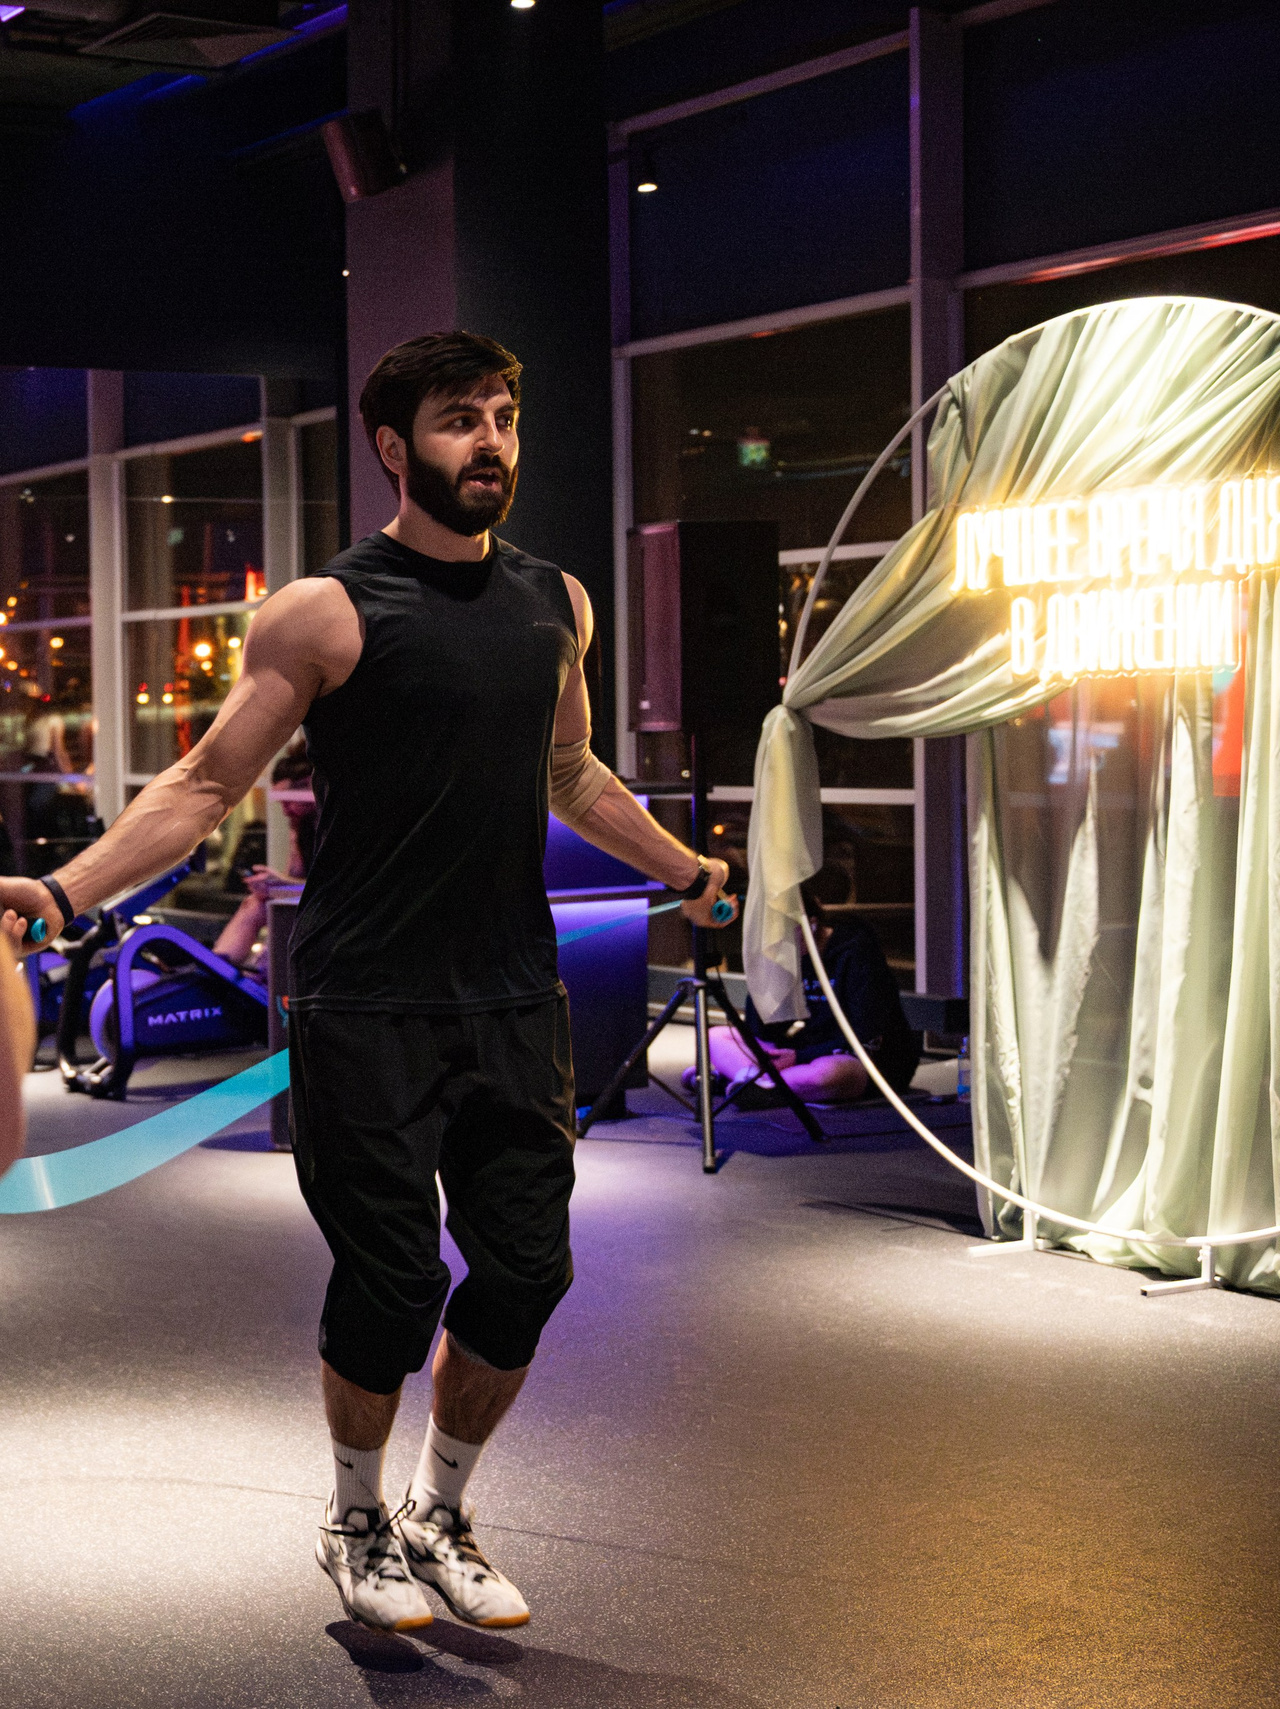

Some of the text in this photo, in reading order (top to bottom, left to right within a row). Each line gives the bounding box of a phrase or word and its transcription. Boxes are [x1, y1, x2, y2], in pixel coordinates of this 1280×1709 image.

[950, 499, 1084, 590] ЛУЧШЕЕ
[1088, 484, 1206, 577] ВРЕМЯ
[1011, 580, 1235, 680] В ДВИЖЕНИИ
[148, 1006, 222, 1027] MATRIX
